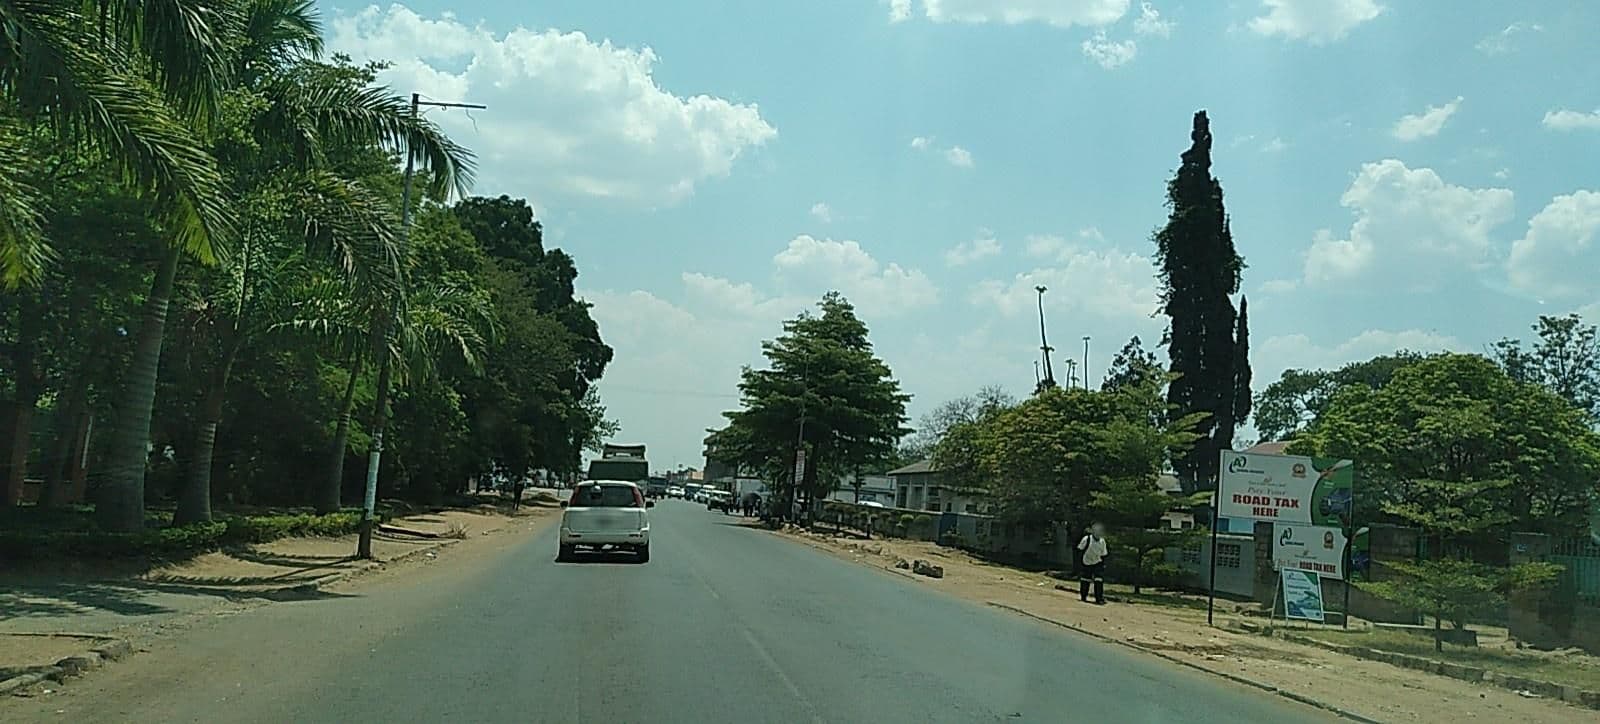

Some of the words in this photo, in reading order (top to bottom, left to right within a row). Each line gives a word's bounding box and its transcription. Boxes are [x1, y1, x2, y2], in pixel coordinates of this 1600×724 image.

[1232, 494, 1271, 506] ROAD
[1273, 497, 1299, 509] TAX
[1252, 507, 1279, 518] HERE
[1313, 562, 1323, 572] TAX
[1323, 563, 1336, 574] HERE
